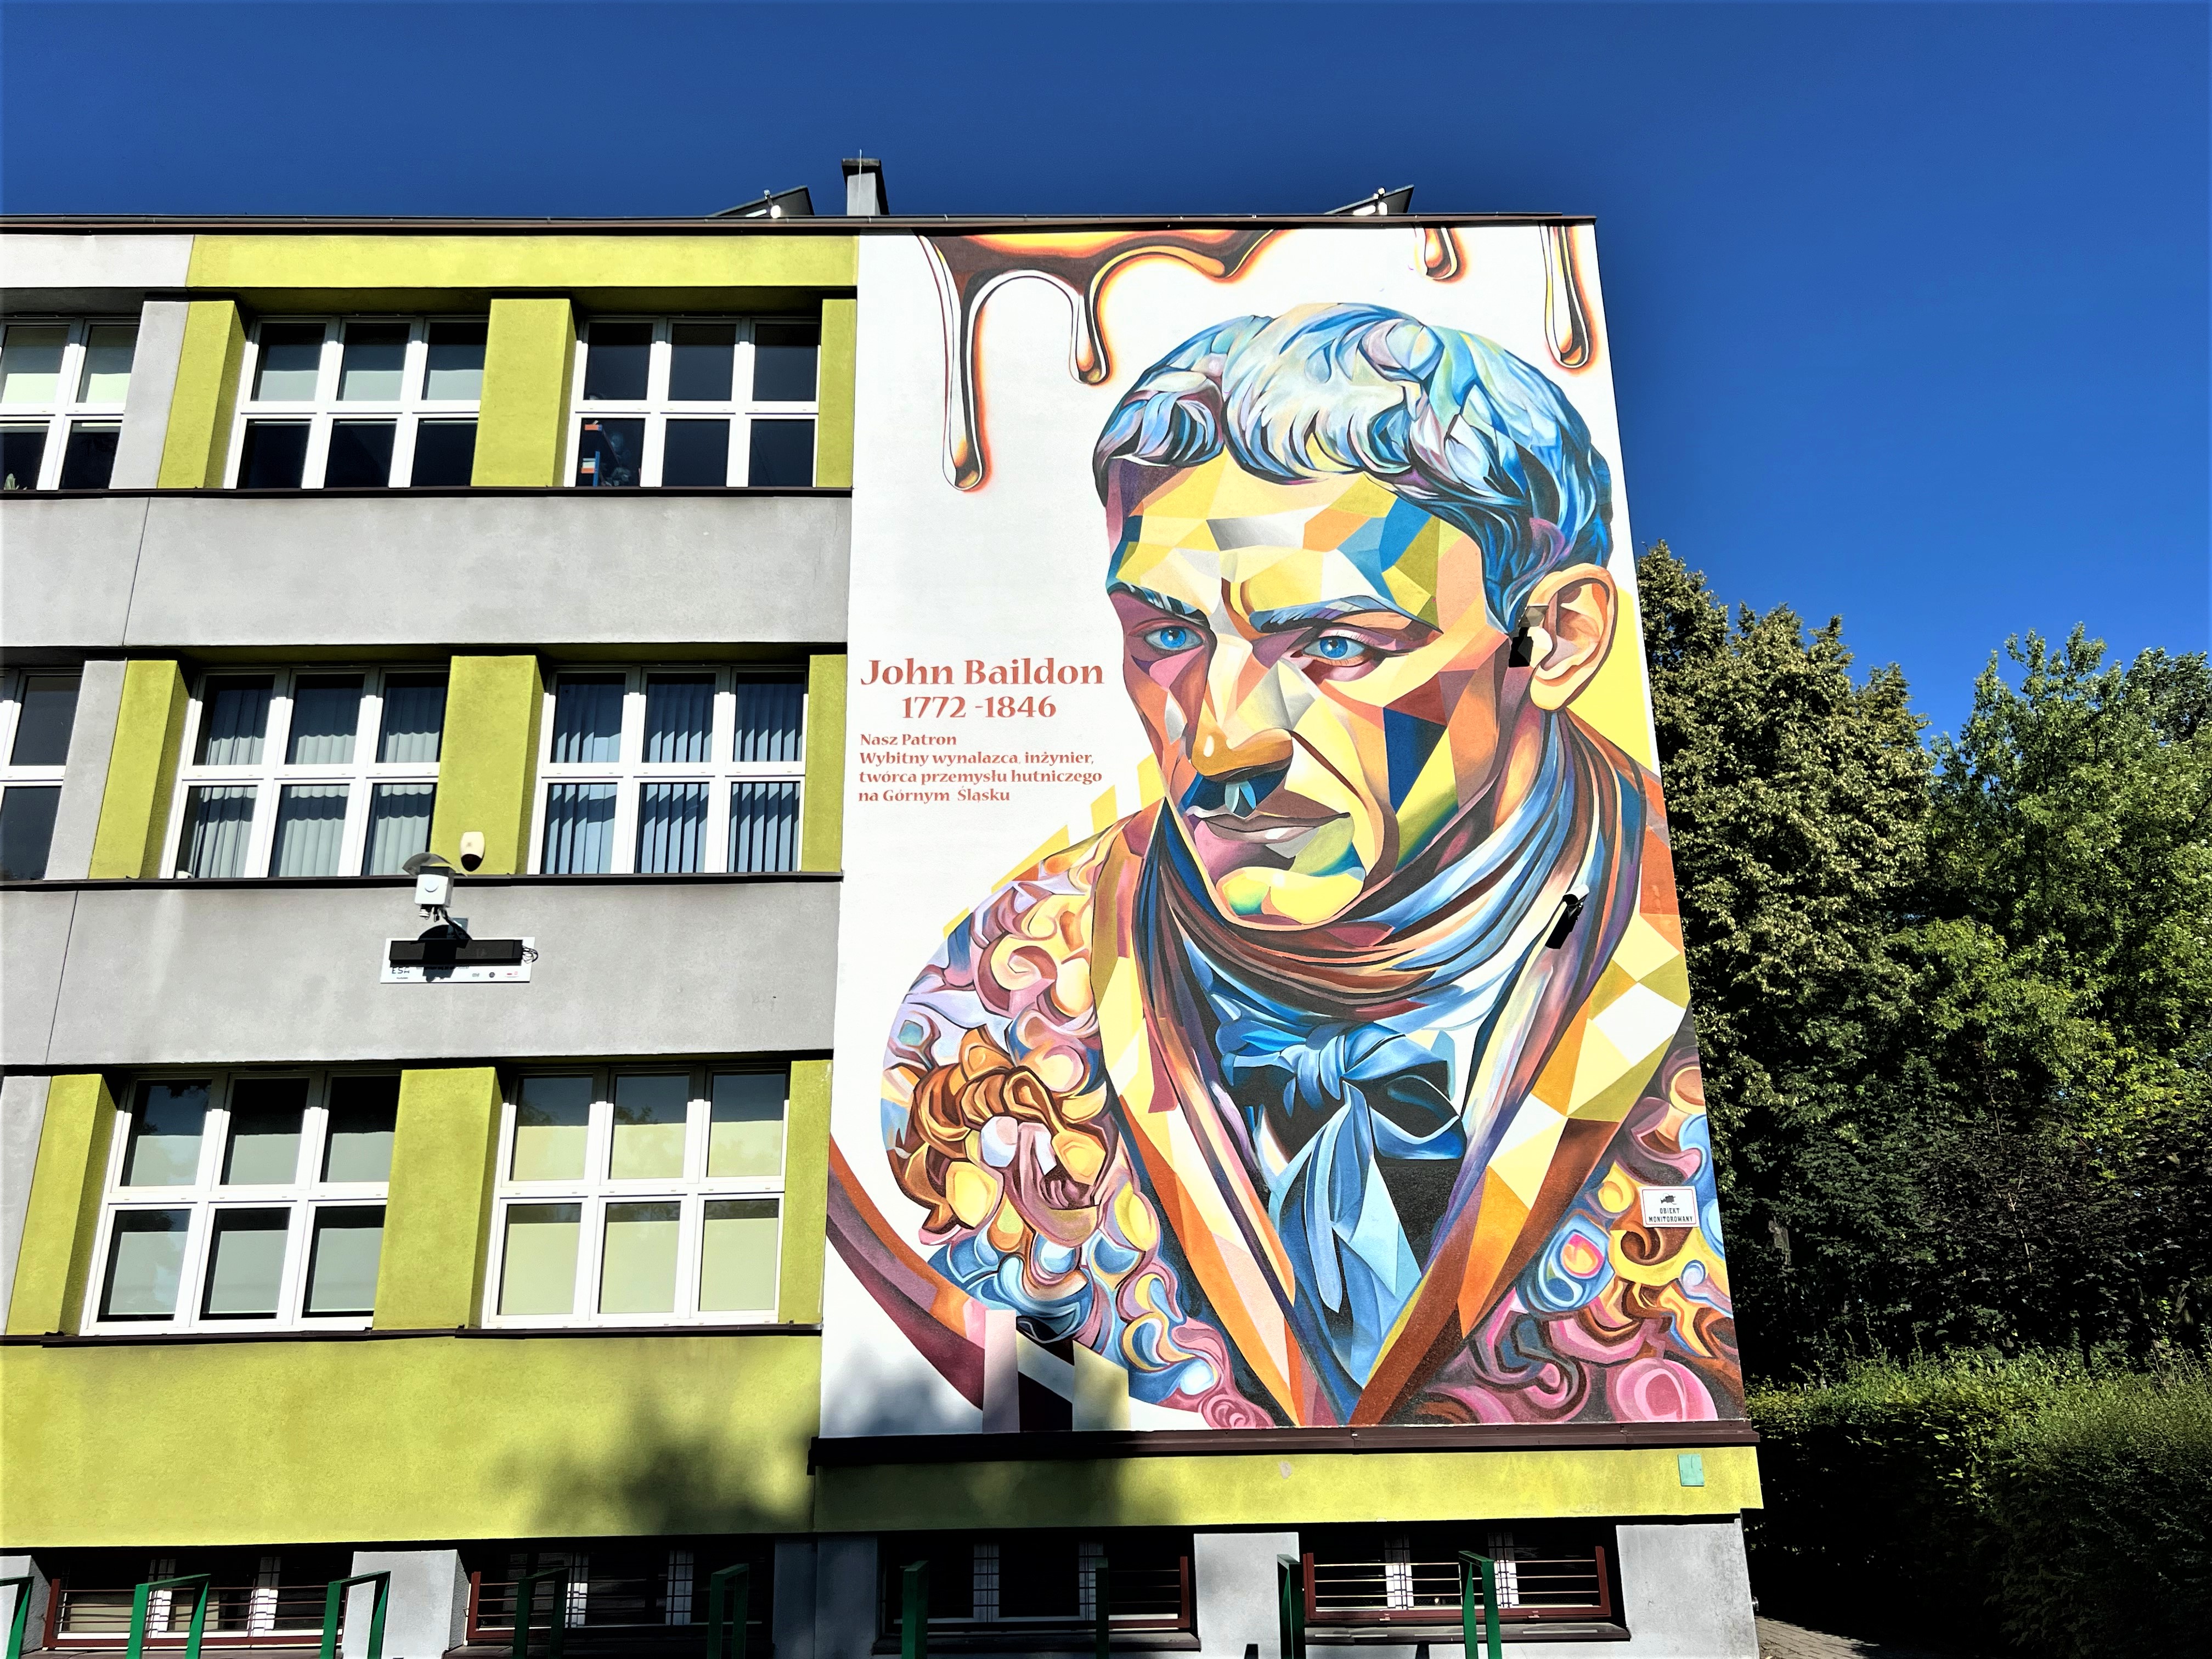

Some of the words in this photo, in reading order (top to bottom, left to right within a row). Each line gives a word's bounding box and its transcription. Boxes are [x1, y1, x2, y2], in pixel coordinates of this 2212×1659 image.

[861, 658, 955, 686] John
[964, 658, 1105, 685] Baildon
[902, 696, 967, 719] 1772
[860, 734, 898, 746] Nasz
[902, 734, 957, 746] Patron
[860, 752, 929, 767] Wybitny
[1025, 752, 1094, 766] inżynier,
[859, 771, 917, 783] twórca
[921, 770, 1007, 785] przemysłu
[1011, 770, 1102, 785] hutniczego
[859, 792, 879, 802] na
[883, 789, 950, 804] Górnym
[957, 786, 1010, 803] Śląsku
